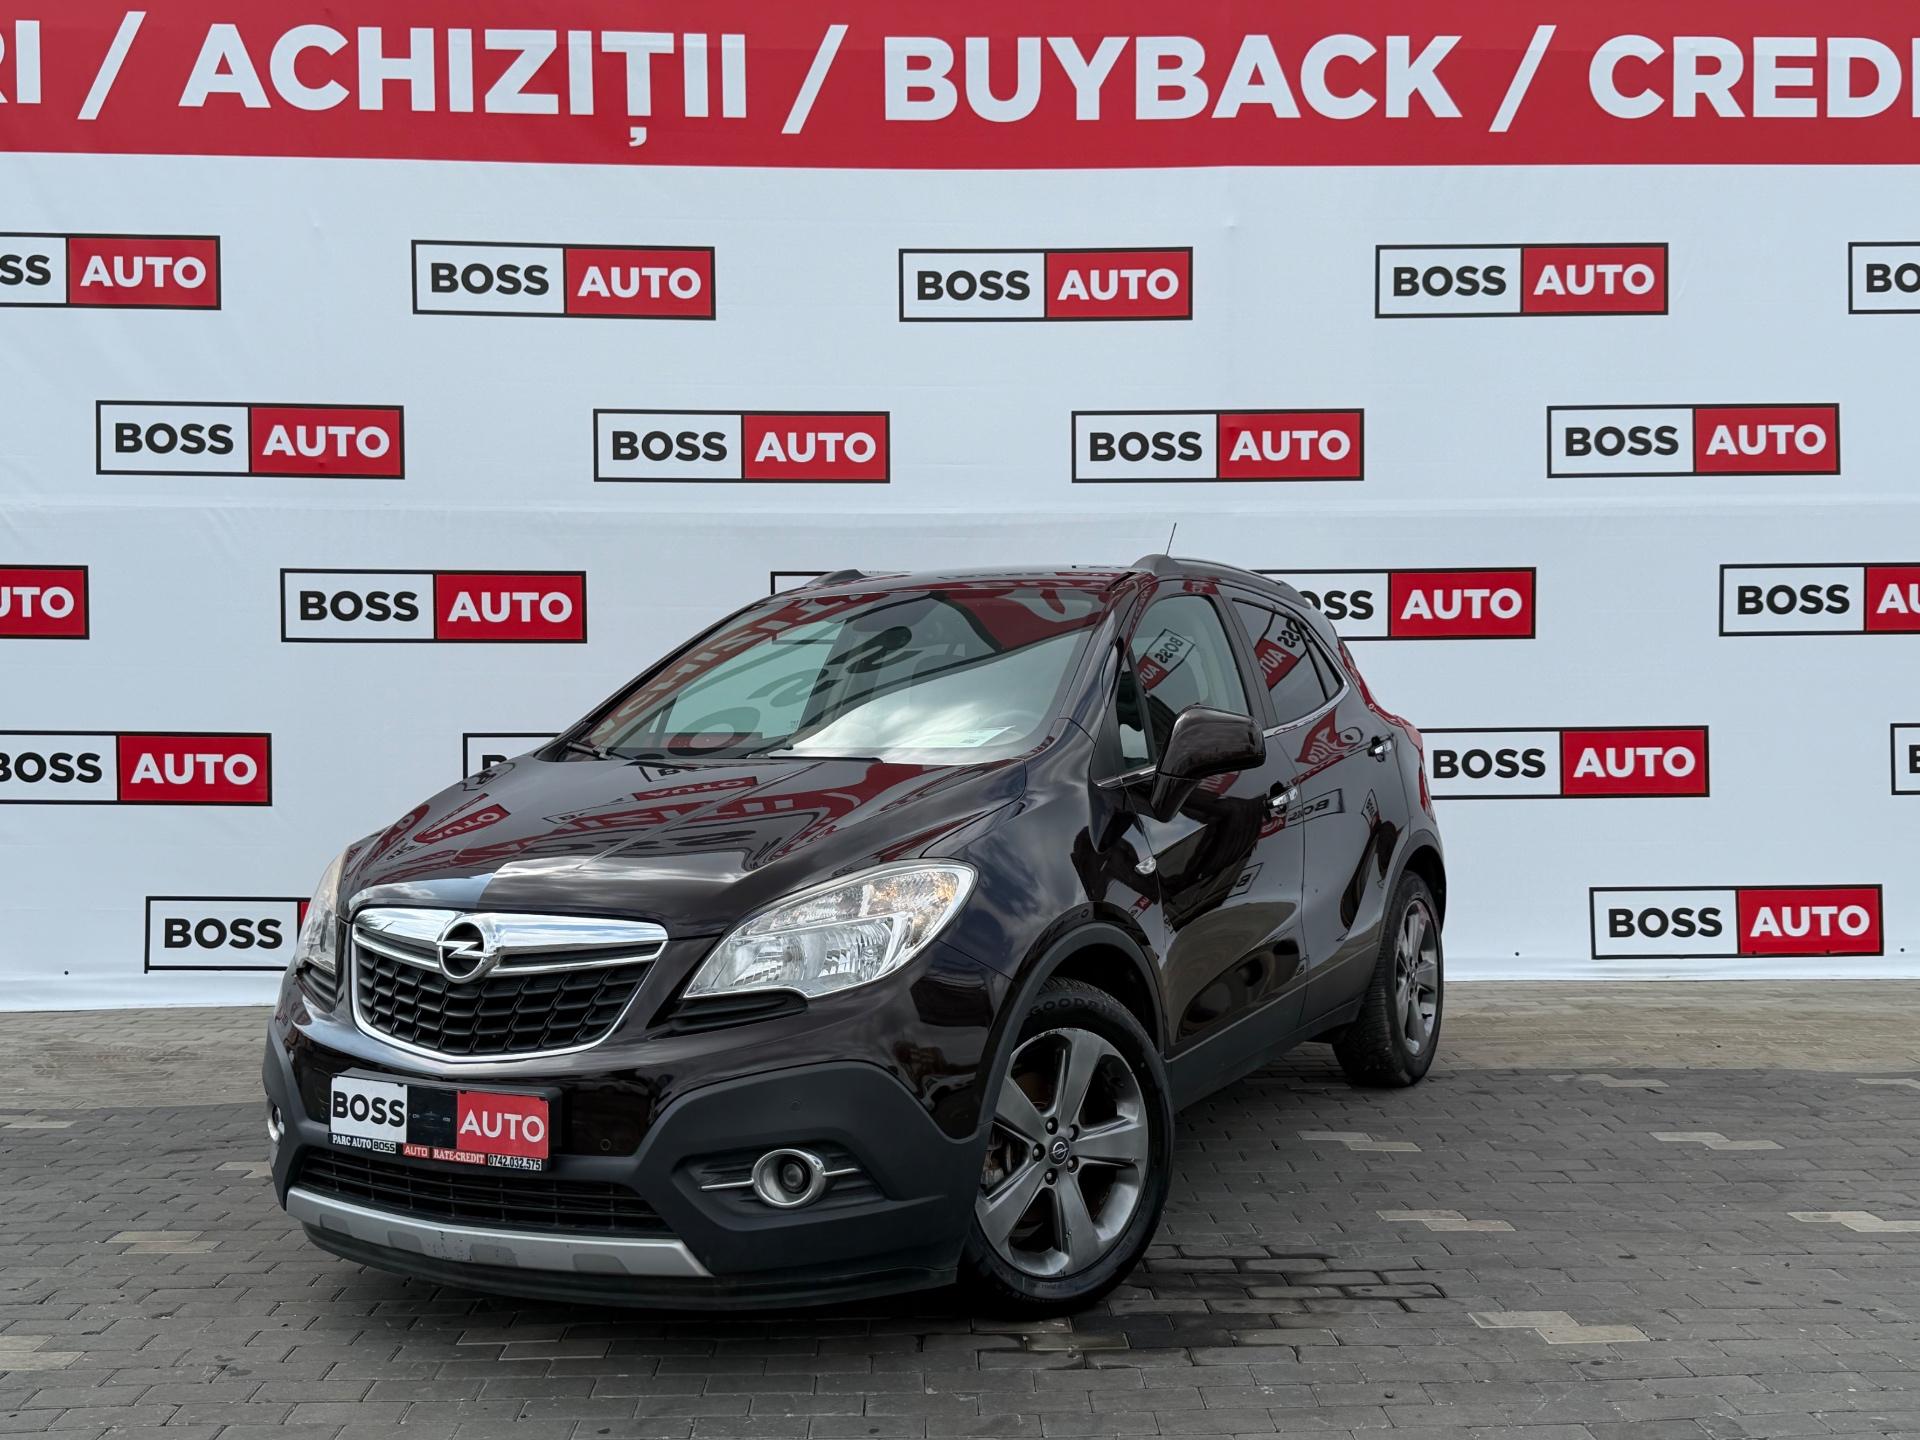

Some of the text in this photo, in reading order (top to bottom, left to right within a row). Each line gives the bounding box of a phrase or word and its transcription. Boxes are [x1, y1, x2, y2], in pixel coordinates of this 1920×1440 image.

[0, 20, 41, 104] I
[179, 23, 746, 147] ACHIZIȚII
[885, 34, 1462, 123] BUYBACK
[81, 256, 206, 288] AUTO
[431, 263, 701, 298] BOSS AUTO
[918, 269, 1178, 300] BOSS AUTO
[1394, 264, 1654, 296] BOSS AUTO
[116, 423, 389, 457] BOSS AUTO
[613, 431, 876, 462] BOSS AUTO
[1090, 430, 1350, 461] BOSS AUTO
[1566, 424, 1826, 456] BOSS AUTO
[300, 591, 572, 622] BOSS AUTO
[1401, 589, 1521, 619] AUTO
[1738, 584, 1849, 615] BOSS
[131, 754, 257, 784] AUTO
[1433, 747, 1695, 778] BOSS AUTO
[165, 918, 283, 949] BOSS
[1609, 906, 1869, 937] BOSS AUTO
[332, 1091, 545, 1143] BOSS AUTO
[332, 1134, 351, 1146] PARC
[351, 1137, 371, 1149] AUTO
[373, 1140, 396, 1153] BOSS
[403, 1146, 428, 1158] AUTO
